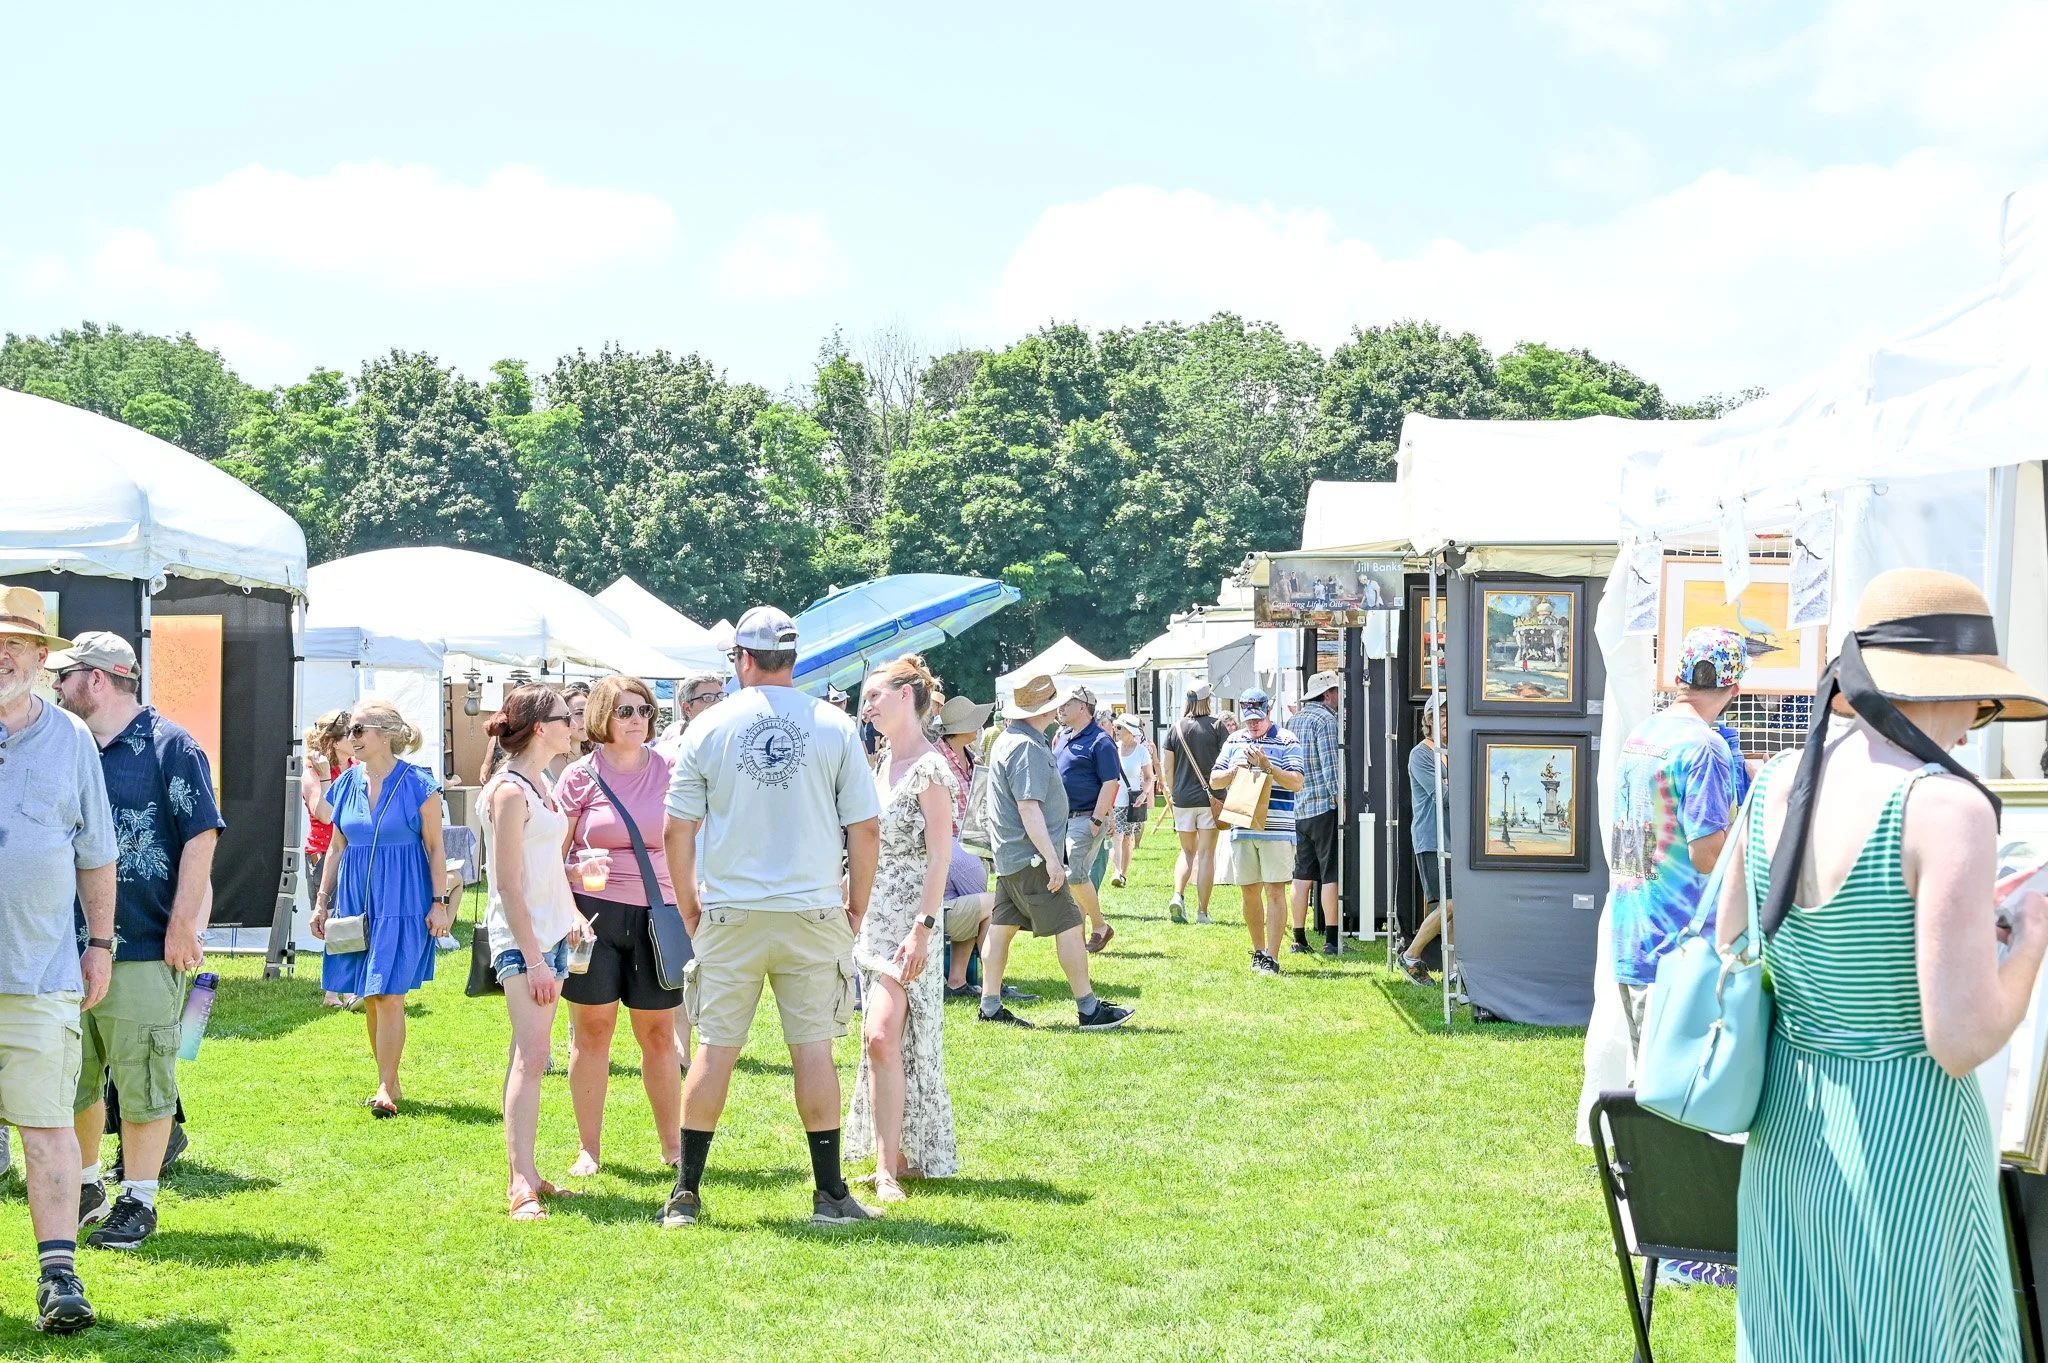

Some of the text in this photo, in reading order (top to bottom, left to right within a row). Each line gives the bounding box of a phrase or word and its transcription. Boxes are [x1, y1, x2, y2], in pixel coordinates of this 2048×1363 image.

[1356, 561, 1402, 573] Jill Banks
[1271, 600, 1305, 609] Capturing
[1329, 600, 1343, 608] Oils
